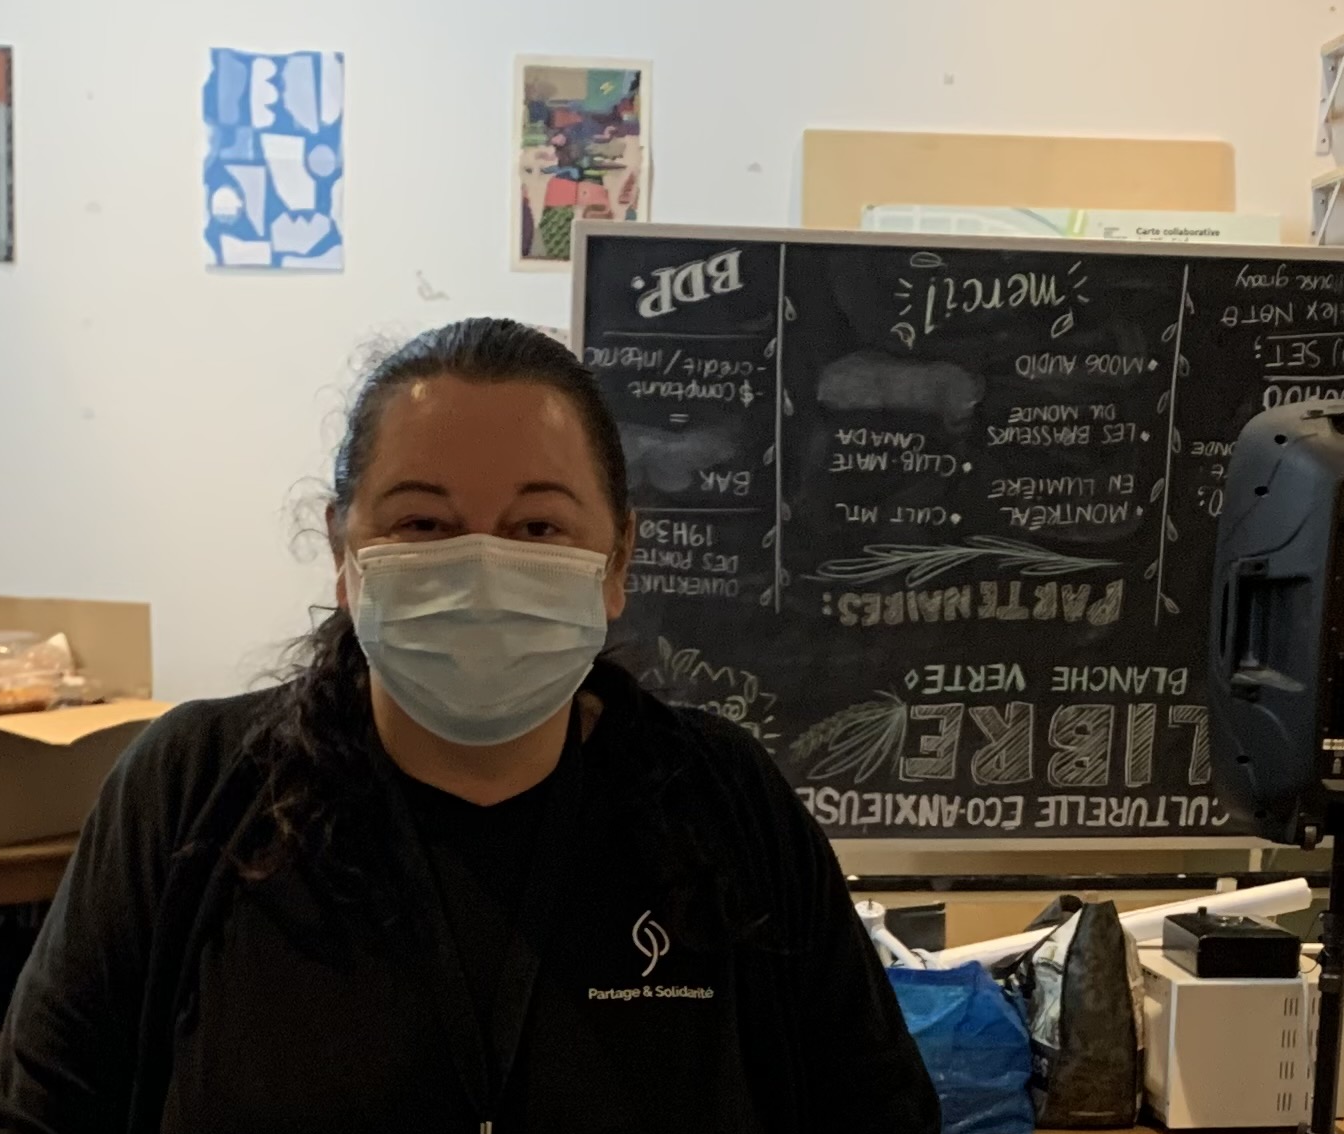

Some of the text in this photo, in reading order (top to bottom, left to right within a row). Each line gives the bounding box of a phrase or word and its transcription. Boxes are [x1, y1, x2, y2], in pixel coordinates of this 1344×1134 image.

[1136, 226, 1160, 236] Carte
[1163, 226, 1220, 237] collaborative
[924, 272, 1064, 334] merci!
[1014, 353, 1077, 380] AUDIO
[1007, 403, 1116, 424] DU MONDE
[834, 427, 926, 451] CANADA
[986, 422, 1136, 447] LES BRASSEURS
[699, 470, 752, 496] BAR
[1108, 474, 1134, 496] EN
[835, 503, 947, 526] CULT MTL
[999, 501, 1128, 530] MONTRÉAL
[638, 519, 714, 549] 19H30
[634, 548, 693, 570] PORTE
[922, 663, 1189, 697] BLANCHE VERTE
[898, 701, 1213, 788] LIBRE
[588, 985, 715, 1001] Partage & Solidarité
